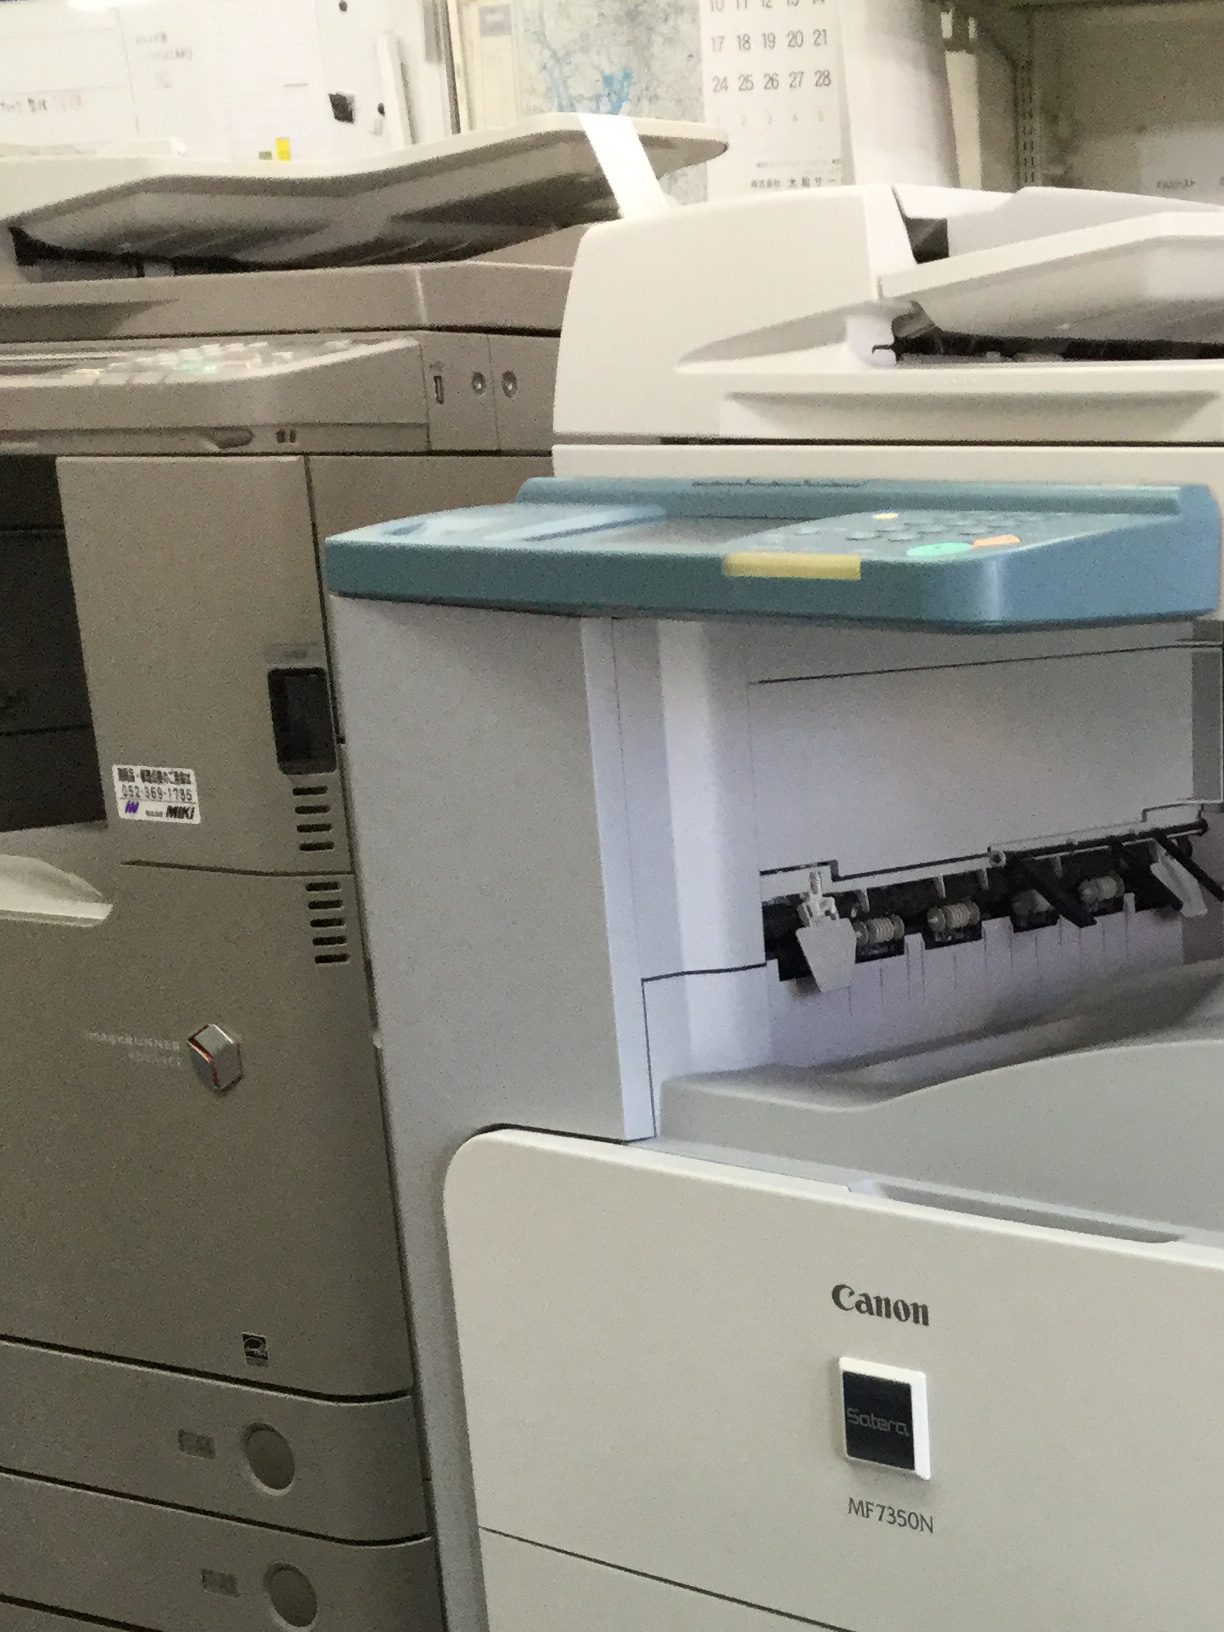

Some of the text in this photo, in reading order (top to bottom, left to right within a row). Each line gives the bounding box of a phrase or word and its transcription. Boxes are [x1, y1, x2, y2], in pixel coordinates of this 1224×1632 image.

[711, 28, 828, 52] 17 18 19 20 21
[712, 69, 832, 93] 24 25 26 27 28
[831, 1283, 930, 1327] Canon
[846, 1407, 910, 1437] Satera
[847, 1496, 934, 1534] MF7350N
